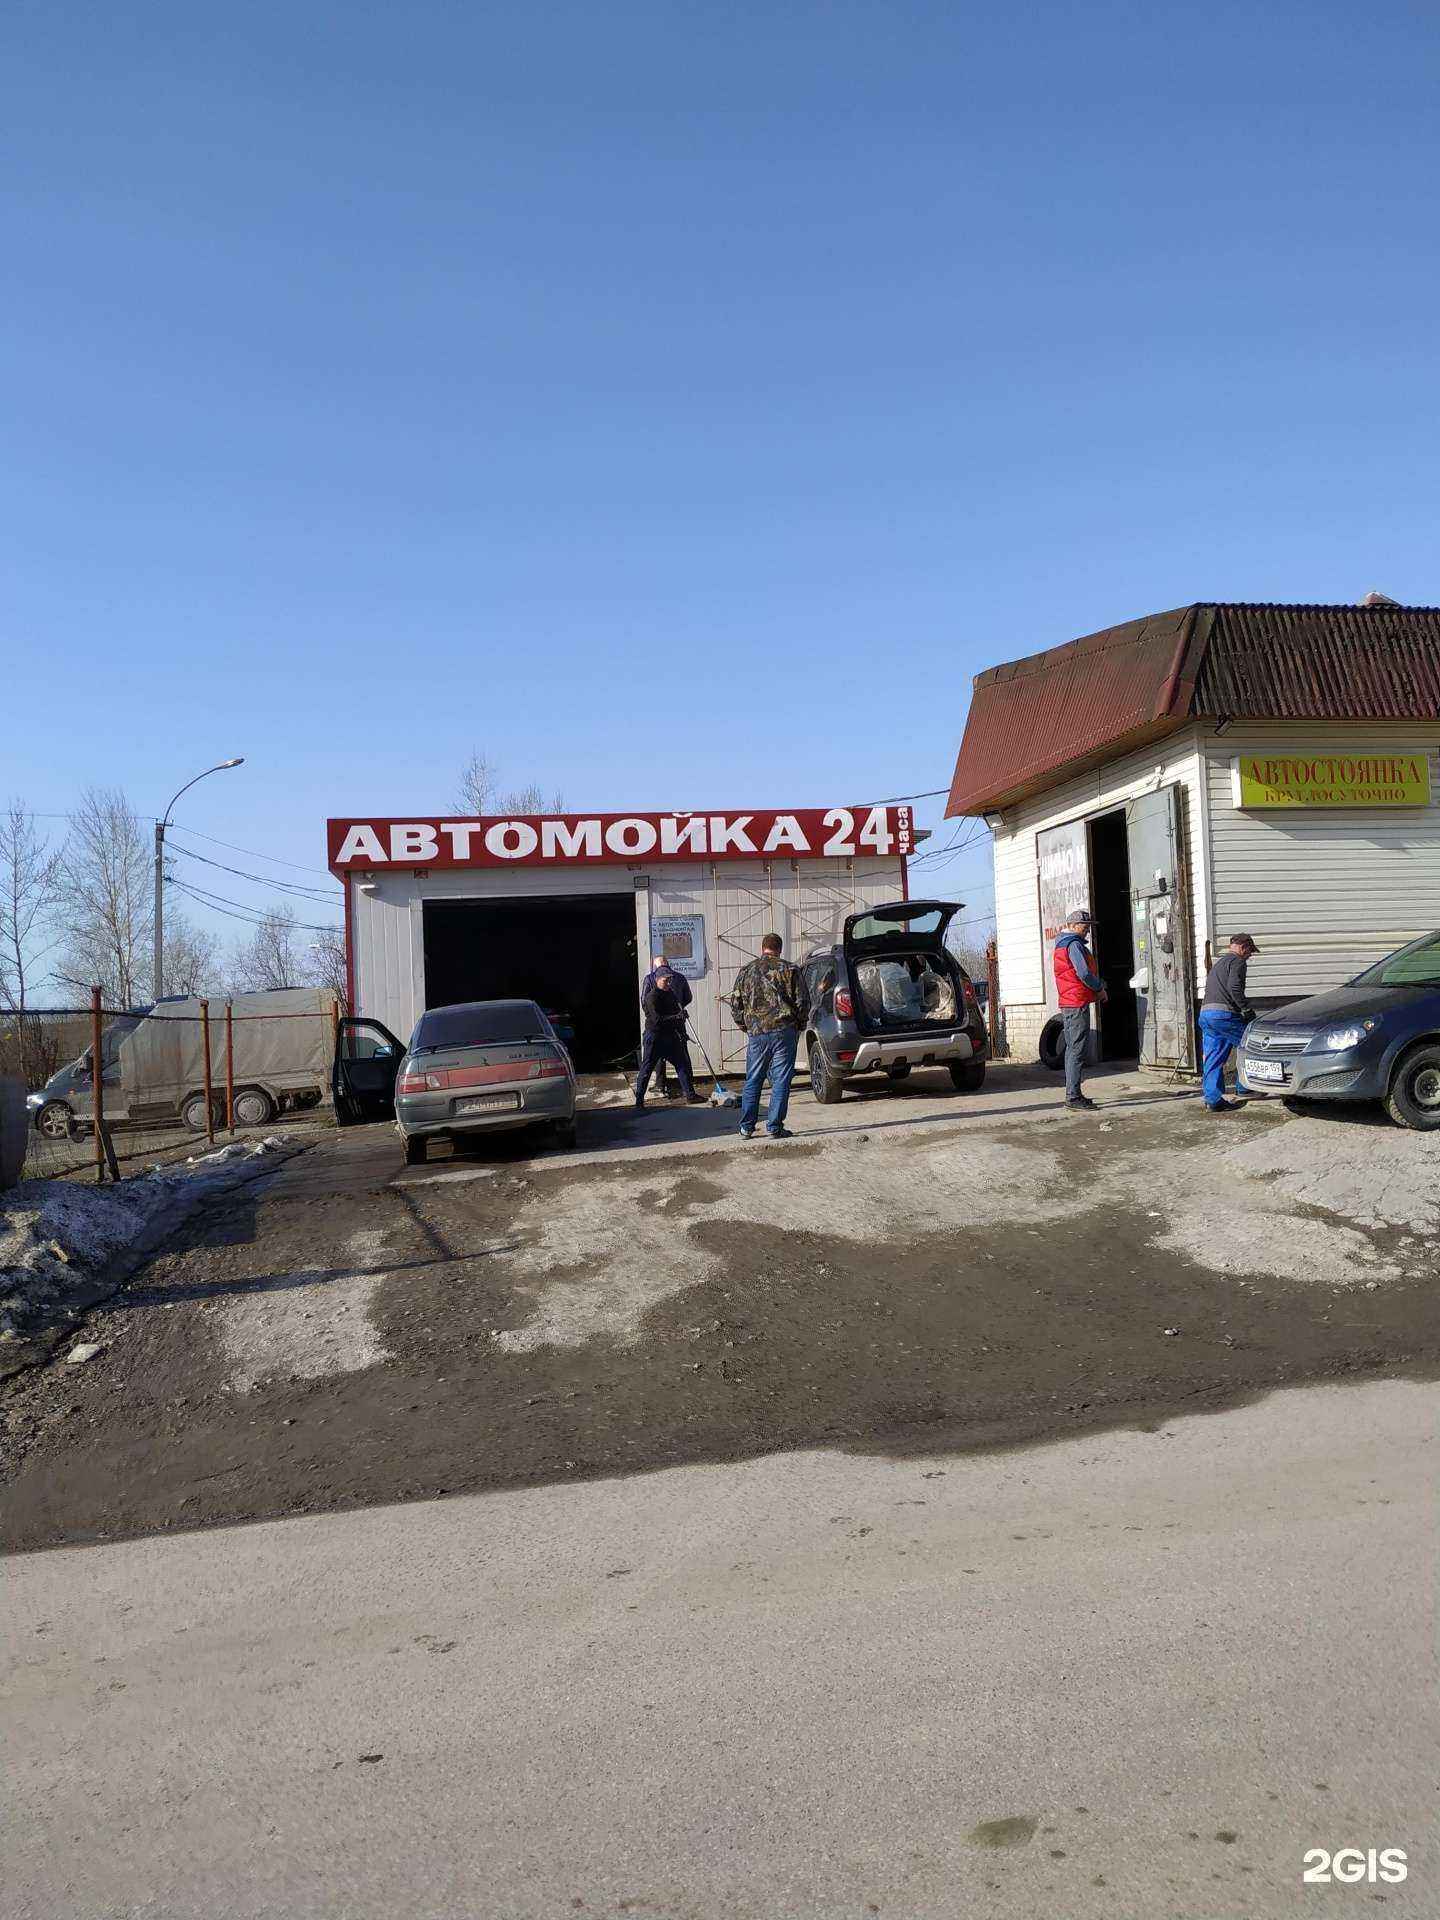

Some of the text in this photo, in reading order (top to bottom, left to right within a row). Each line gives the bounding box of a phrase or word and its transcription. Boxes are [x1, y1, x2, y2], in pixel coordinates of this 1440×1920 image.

[1250, 759, 1422, 785] АВТОСТОЯНКА
[335, 807, 894, 863] АВТОМОЙКА 24
